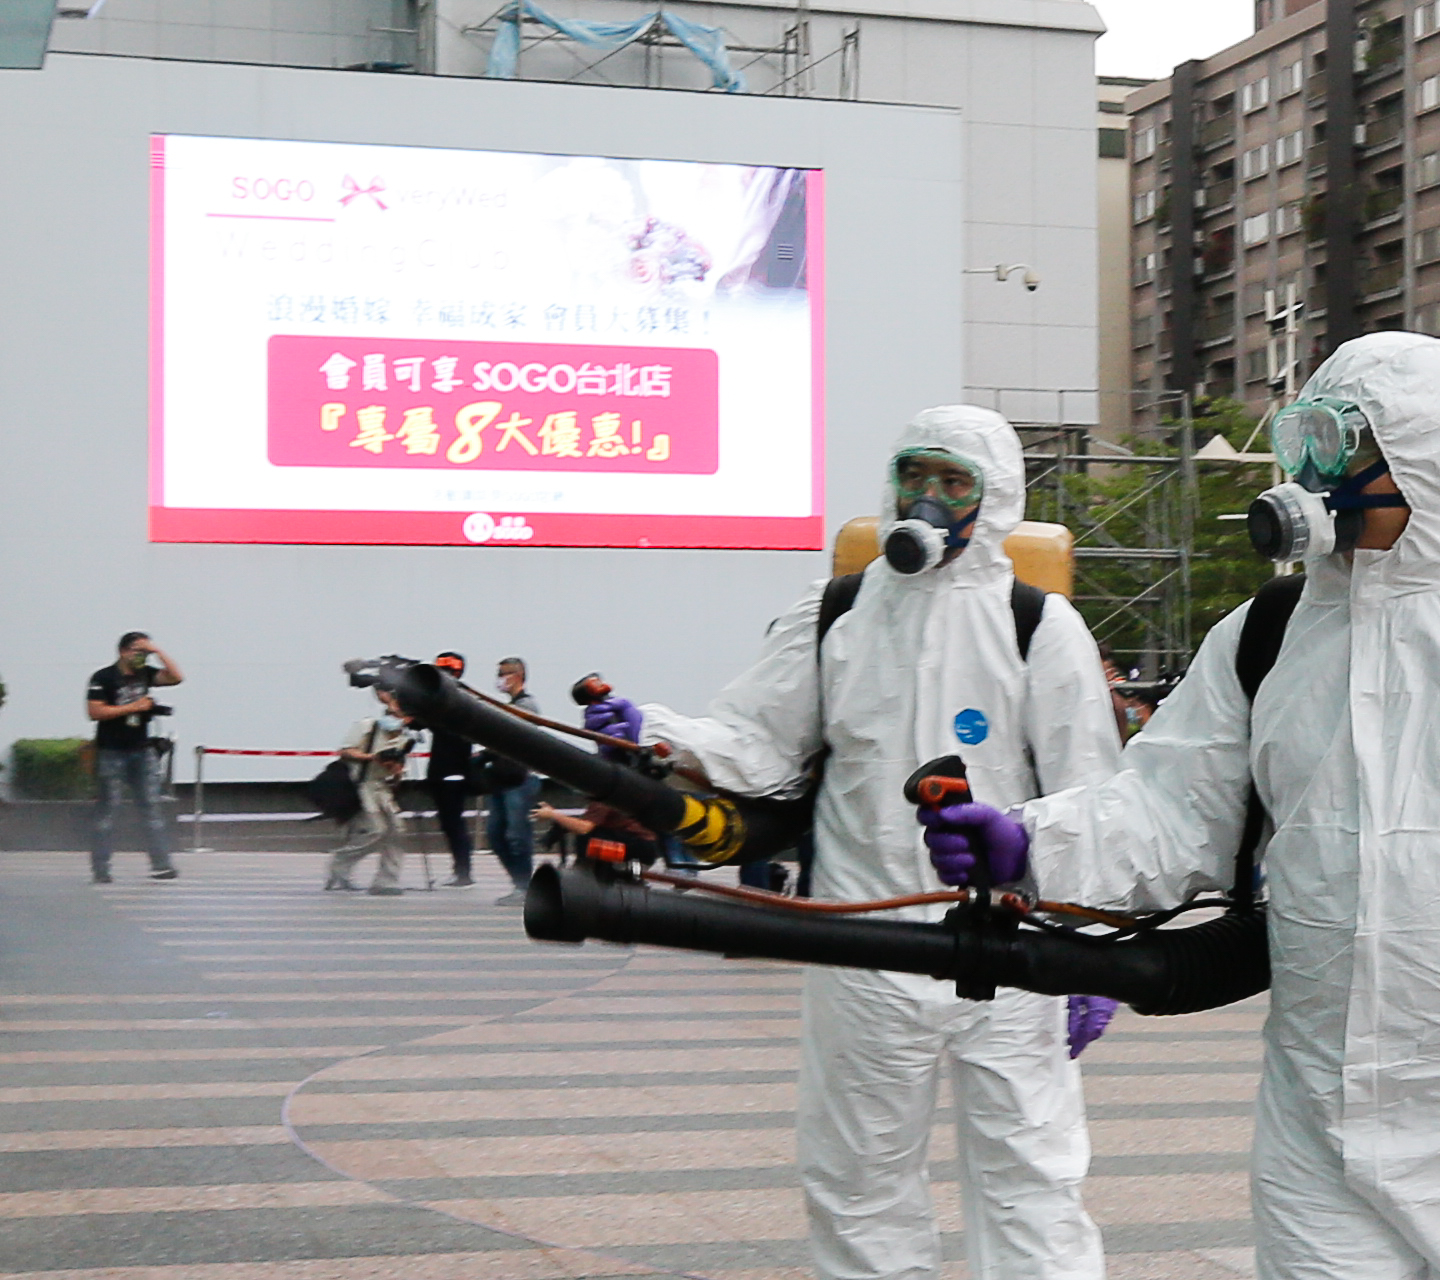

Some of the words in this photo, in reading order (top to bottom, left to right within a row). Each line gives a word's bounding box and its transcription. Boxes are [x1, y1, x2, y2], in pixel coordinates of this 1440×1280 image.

[231, 176, 315, 203] SOGO
[319, 352, 464, 392] 會員可享
